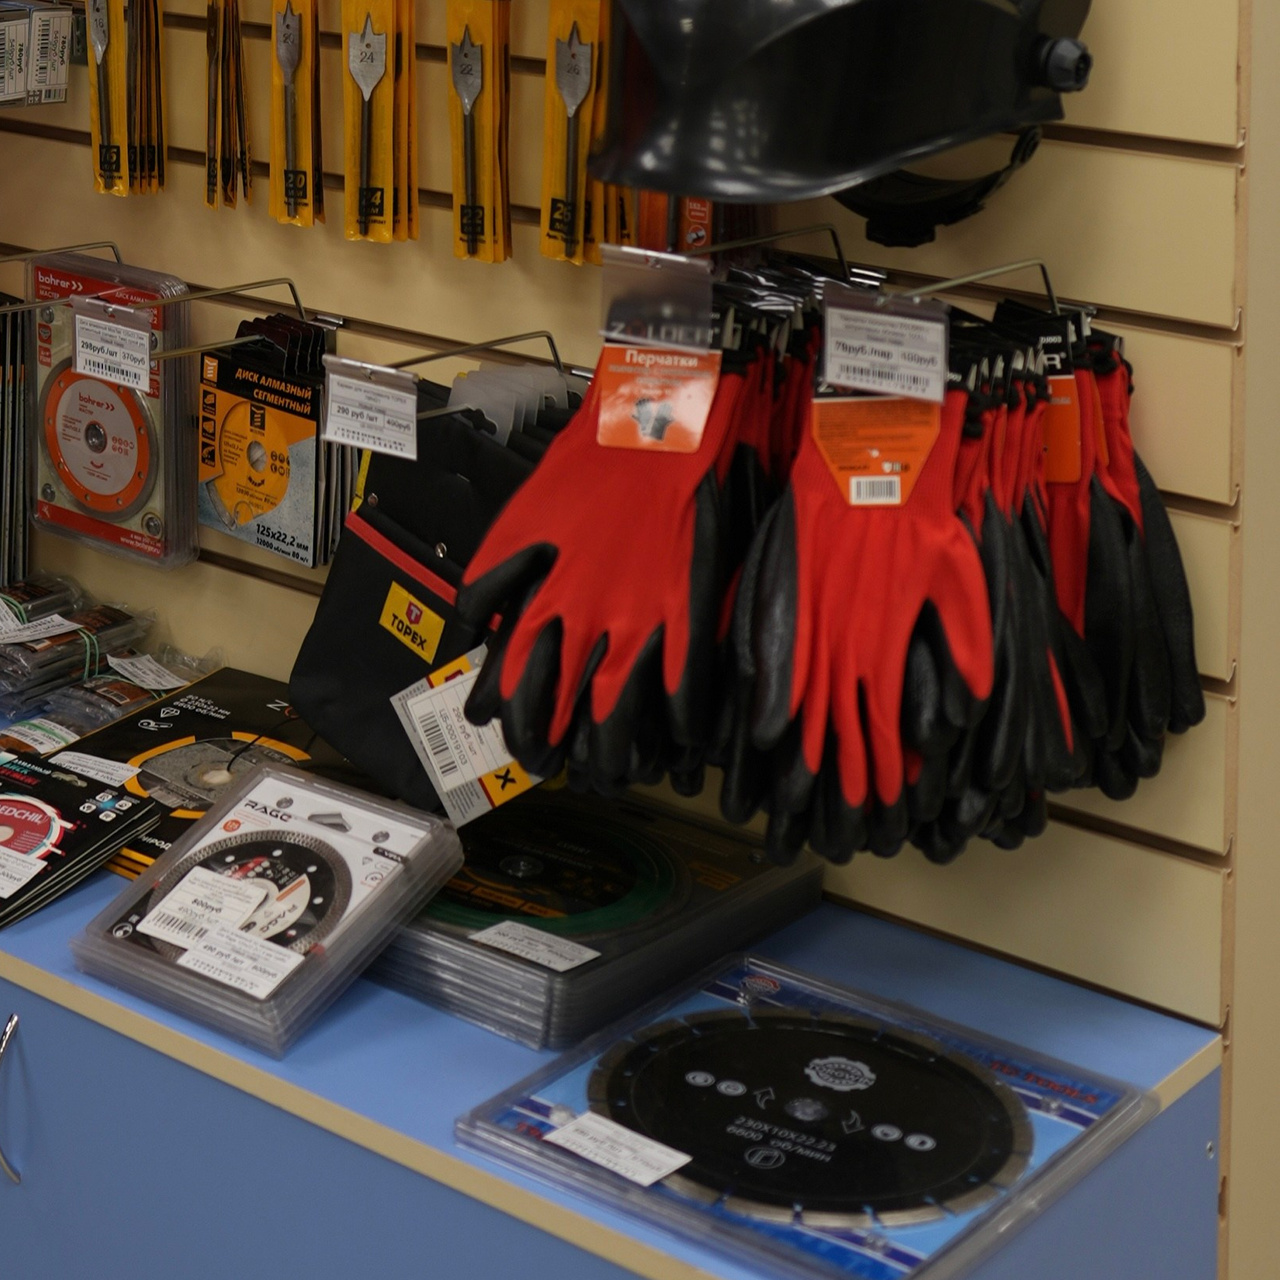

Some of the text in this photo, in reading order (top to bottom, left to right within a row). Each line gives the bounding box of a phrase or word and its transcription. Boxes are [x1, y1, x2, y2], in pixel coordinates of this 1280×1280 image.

[59, 35, 67, 66] 780руб
[359, 51, 375, 64] 24
[459, 63, 474, 76] 22
[566, 62, 581, 76] 26
[38, 271, 70, 288] bohrer
[81, 340, 118, 357] 298руб./шт
[625, 349, 698, 368] Перчатки
[235, 368, 312, 399] ДИСК АЛМАЗНЫЙ
[79, 392, 105, 409] bohrer
[253, 388, 311, 415] СЕГМЕНТНЫЙ
[336, 405, 350, 416] 290
[256, 523, 309, 552] 125x22,2 мм
[256, 537, 273, 550] 12000
[291, 550, 300, 560] 80
[410, 604, 421, 621] T
[391, 612, 428, 651] TOPEX
